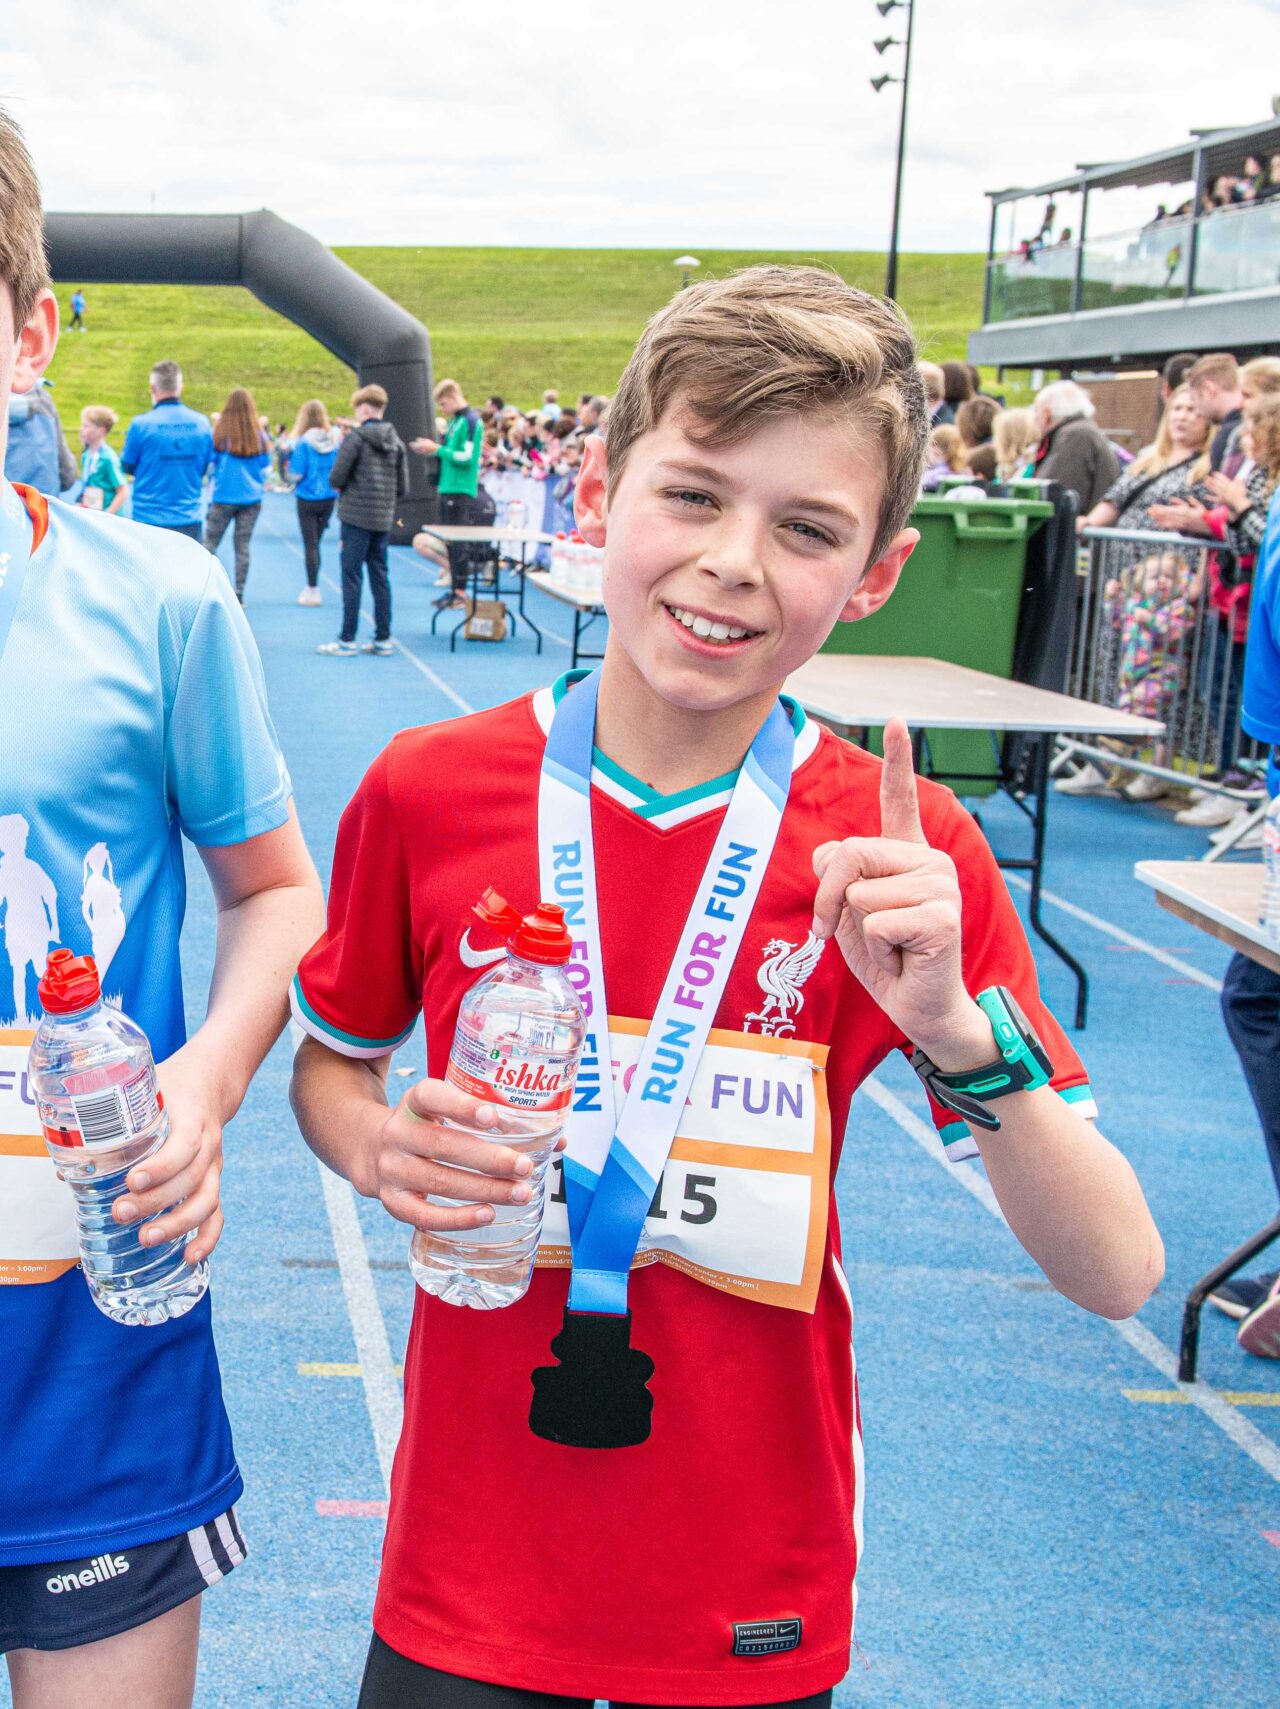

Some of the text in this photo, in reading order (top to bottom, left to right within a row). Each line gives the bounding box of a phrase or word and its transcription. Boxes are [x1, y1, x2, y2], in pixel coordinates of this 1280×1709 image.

[553, 840, 586, 927] RUN
[640, 1018, 696, 1105] RUN
[673, 931, 727, 1010] FOR
[704, 842, 758, 922] FUN
[495, 1059, 562, 1091] ishka
[509, 1095, 538, 1107] SPORTS
[711, 1073, 803, 1118] FUN
[739, 1628, 775, 1637] ENGINEERED
